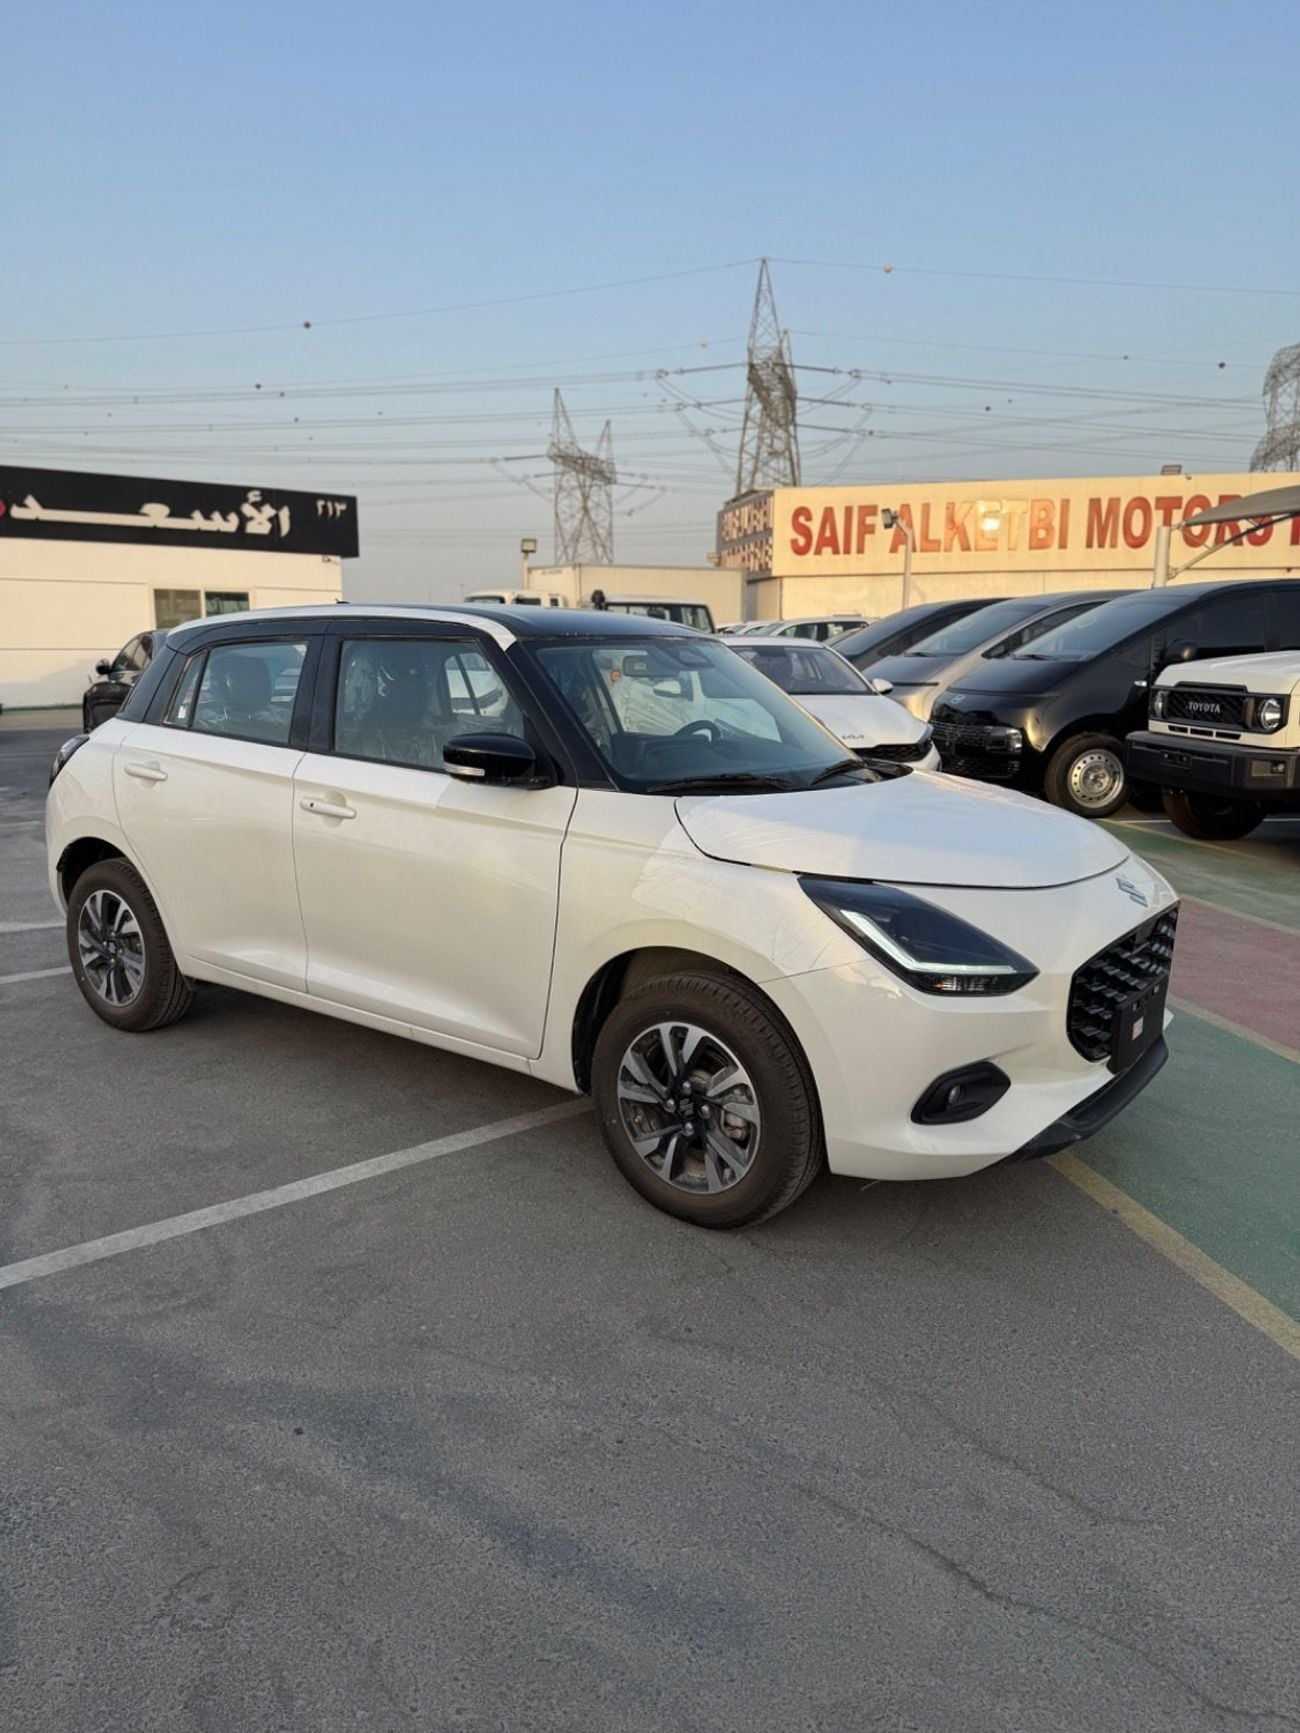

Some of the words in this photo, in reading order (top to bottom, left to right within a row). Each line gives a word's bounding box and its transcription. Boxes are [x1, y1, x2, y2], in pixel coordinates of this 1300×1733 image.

[10, 490, 290, 537] الأسعد
[790, 504, 878, 556] SAIF
[889, 498, 1071, 553] ALKETBI
[1187, 701, 1220, 714] TOYOTA
